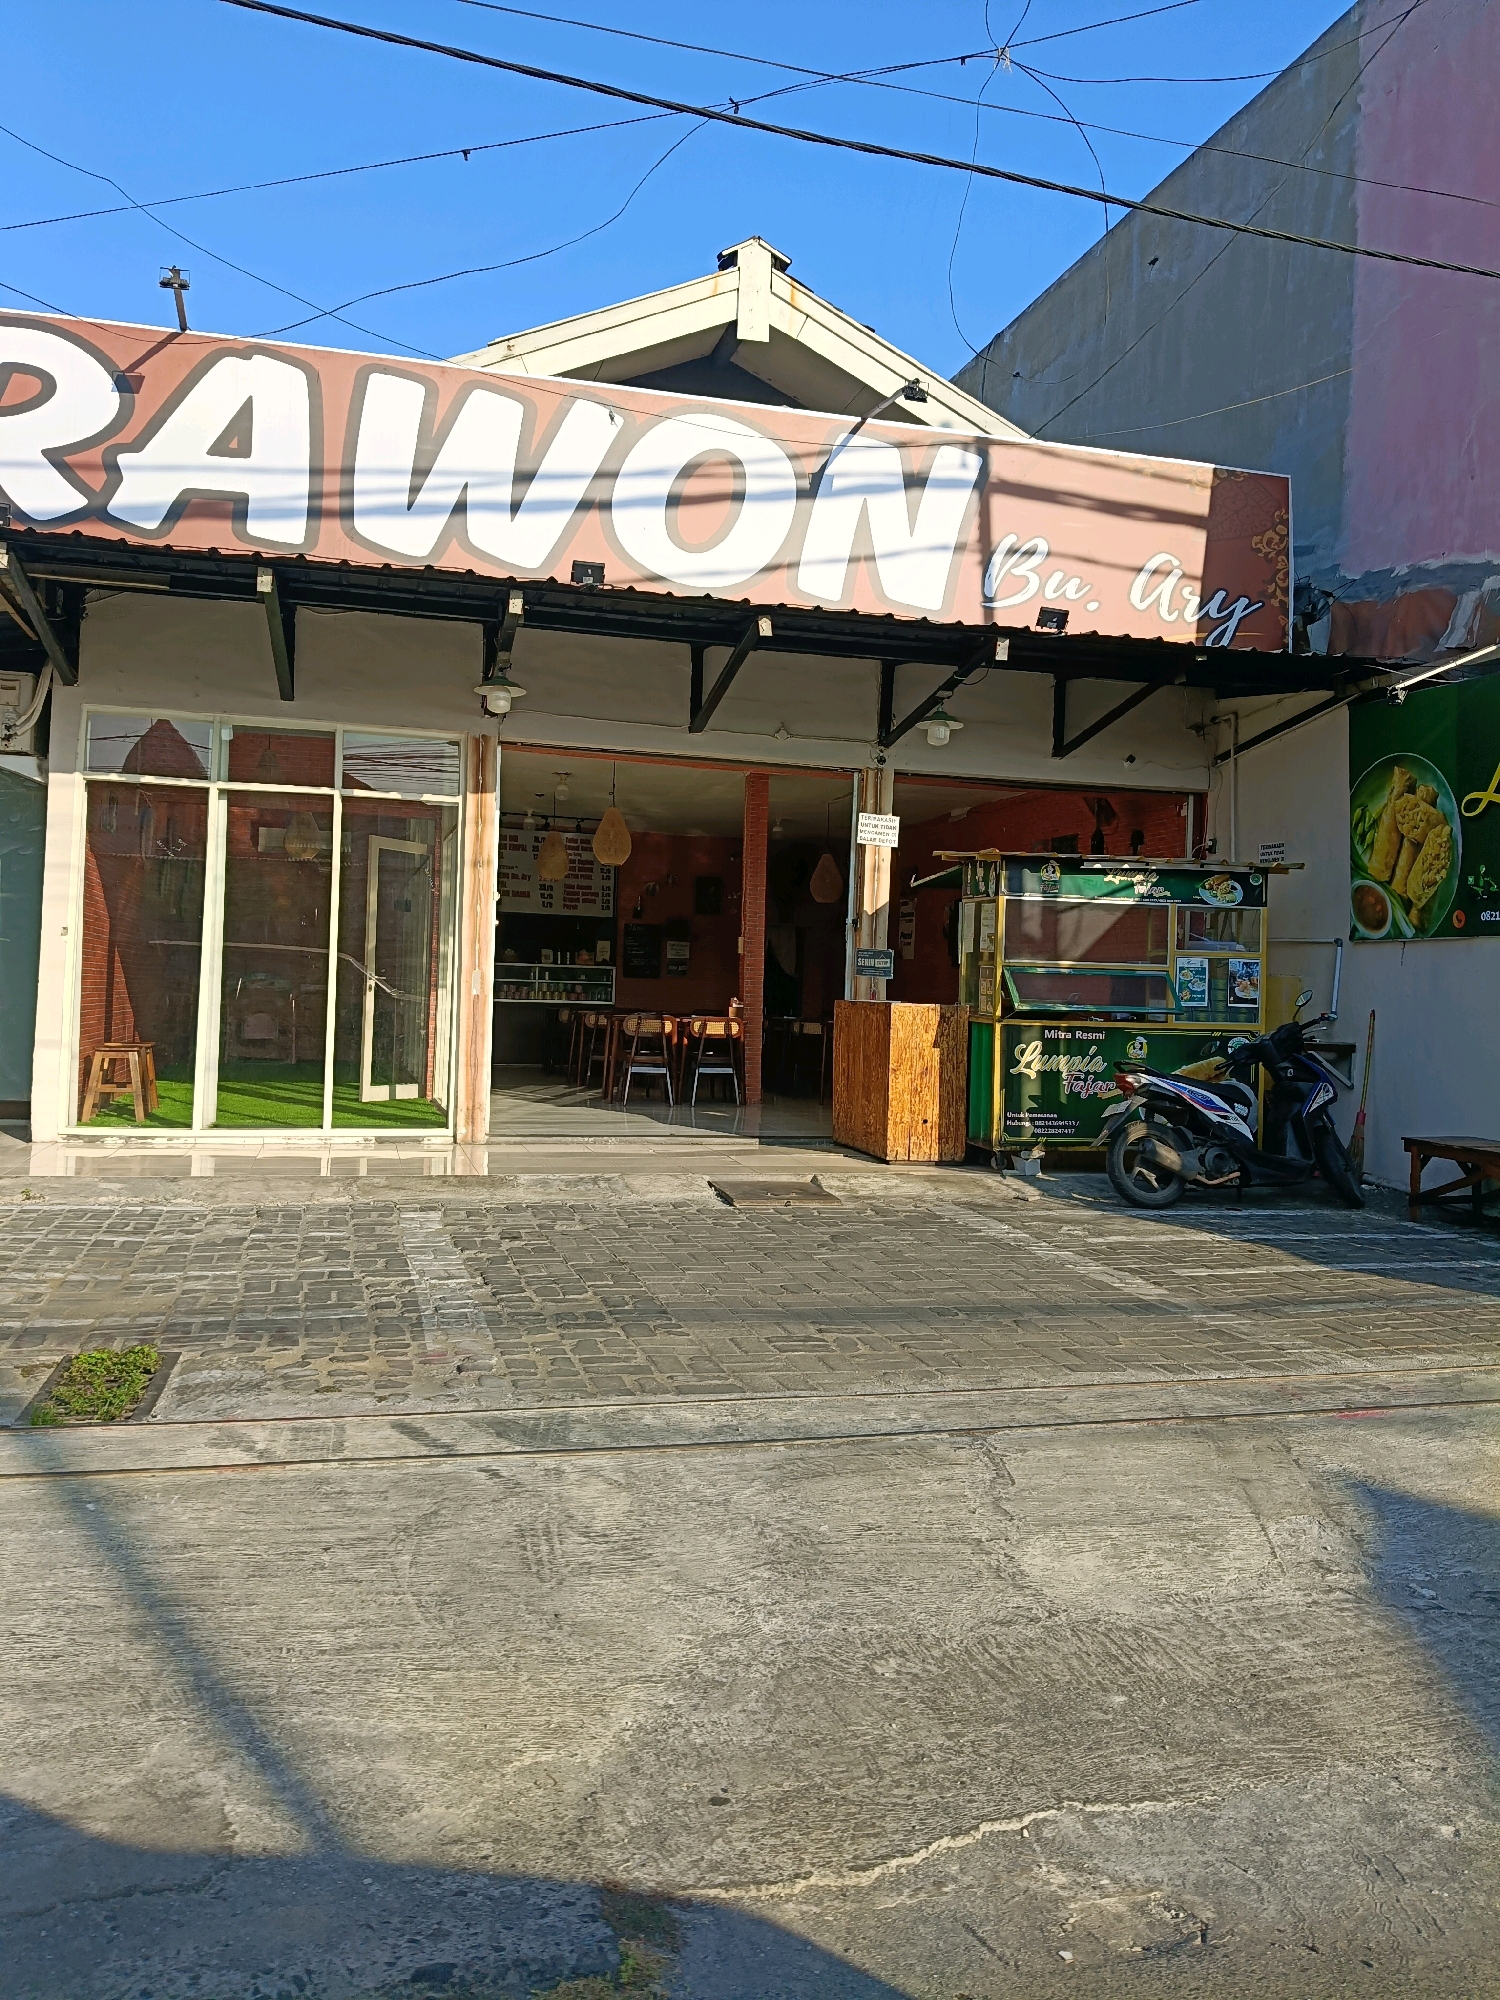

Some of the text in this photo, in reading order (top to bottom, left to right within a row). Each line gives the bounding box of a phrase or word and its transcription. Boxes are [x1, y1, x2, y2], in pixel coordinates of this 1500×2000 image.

[981, 533, 1263, 646] Bu. Ary
[1044, 1029, 1105, 1040] Mitra Resmi
[1010, 1040, 1107, 1079] Lumpia
[1063, 1073, 1116, 1098] Fajar
